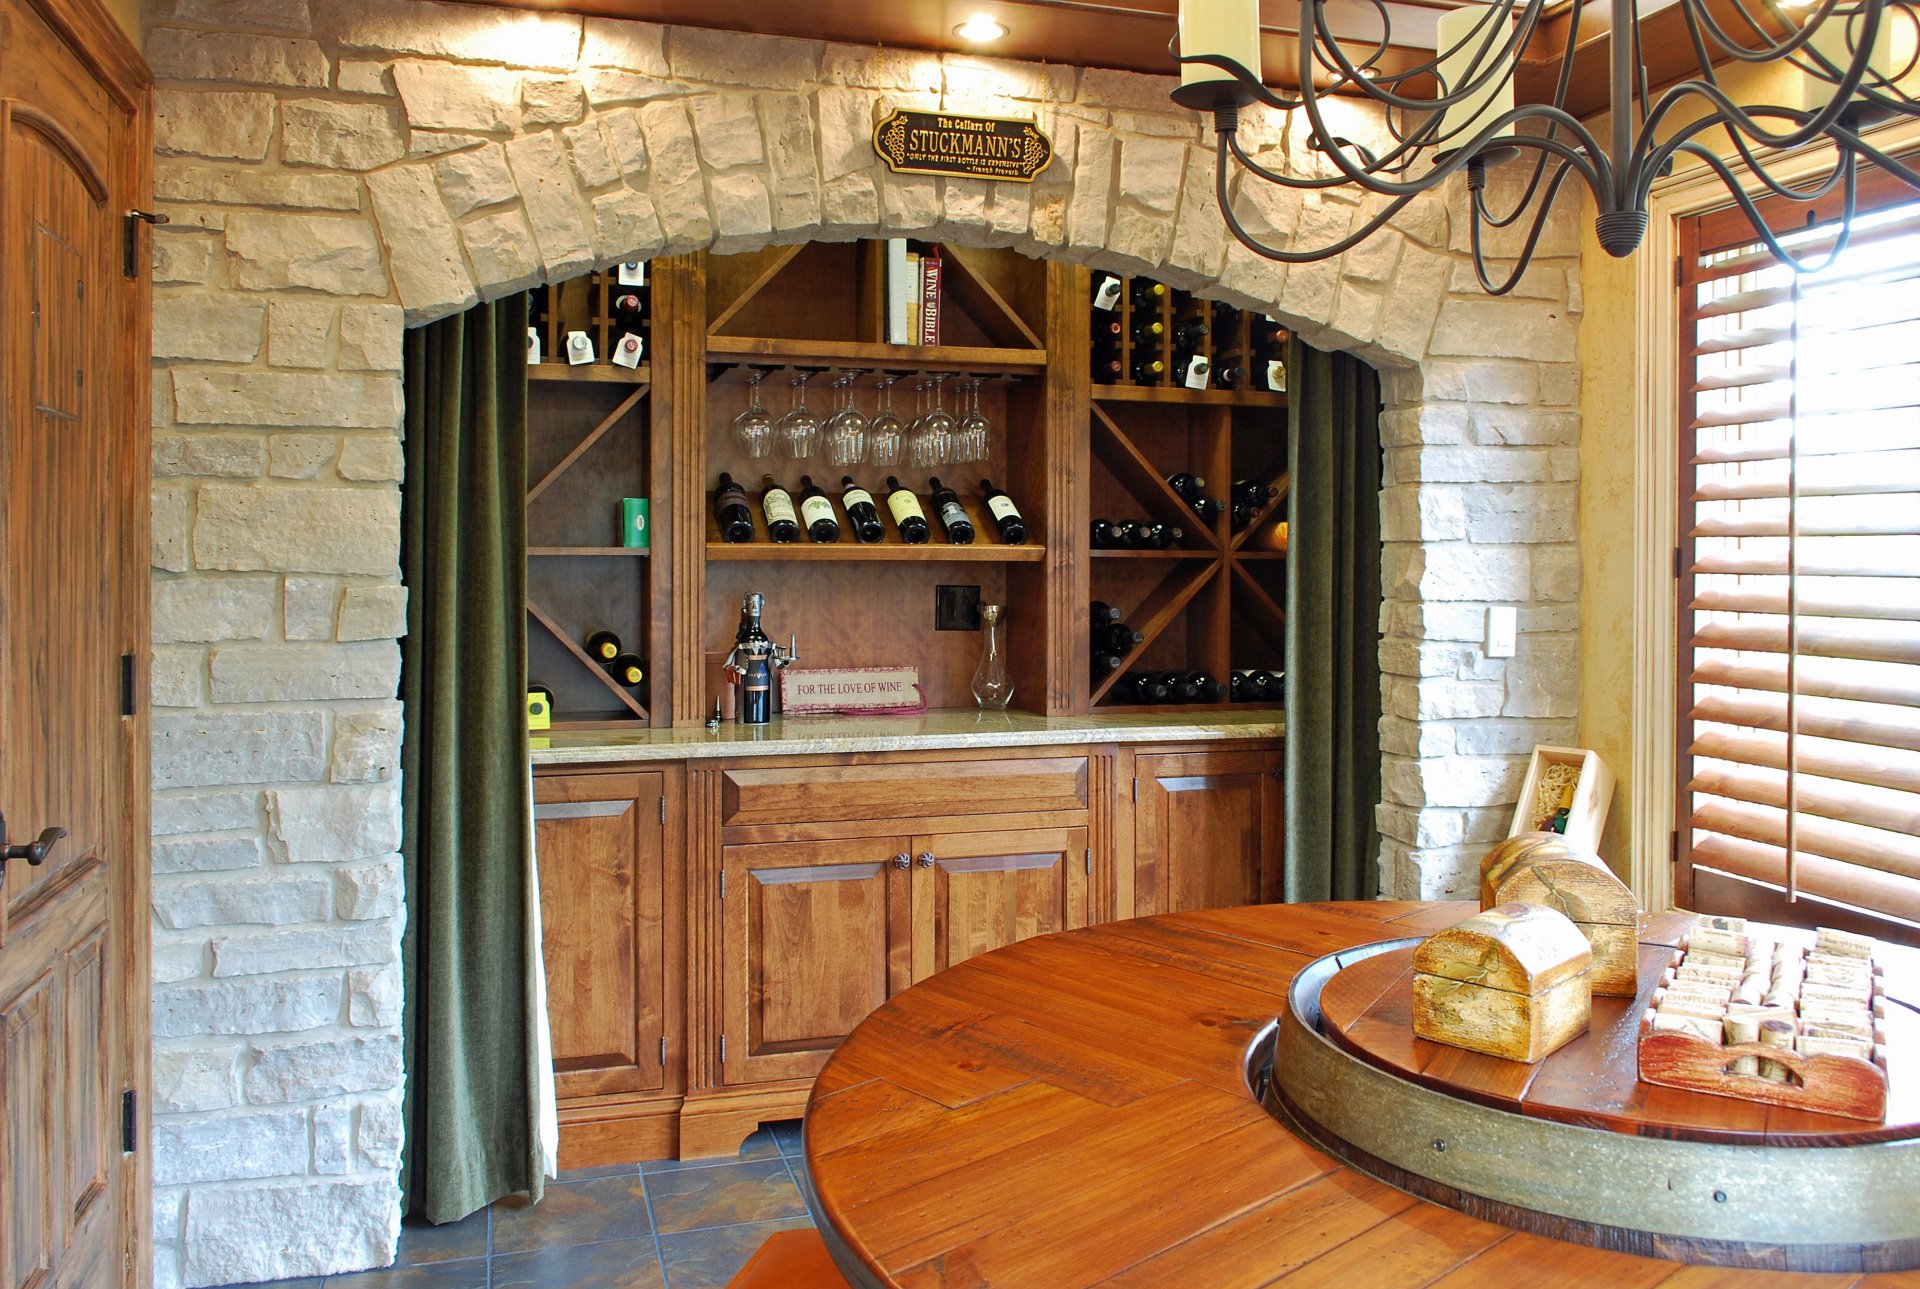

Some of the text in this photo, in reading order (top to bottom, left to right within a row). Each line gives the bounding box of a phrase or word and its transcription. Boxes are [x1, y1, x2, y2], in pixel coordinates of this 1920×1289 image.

[938, 118, 996, 133] The Cellars Of
[909, 129, 1022, 158] STUCKMANN'S
[928, 154, 939, 162] THE
[940, 155, 956, 163] FIRST
[957, 157, 978, 165] BOTTLE
[972, 165, 993, 174] French
[926, 268, 939, 299] WINE
[925, 307, 937, 343] BIBLE
[797, 681, 903, 695] FOR THE LOVE OF WINE
